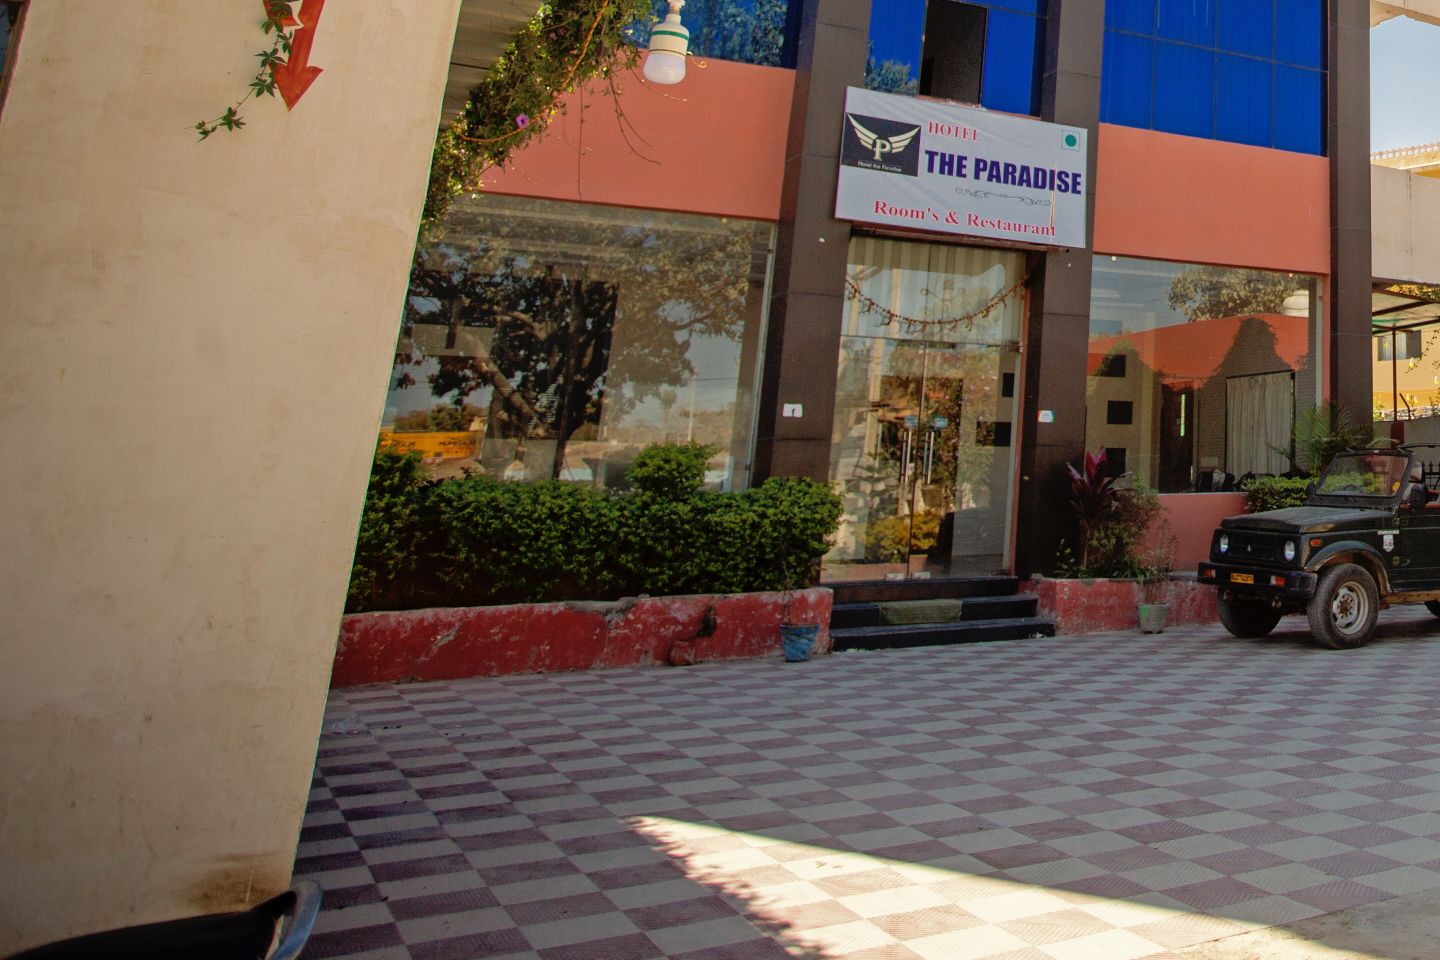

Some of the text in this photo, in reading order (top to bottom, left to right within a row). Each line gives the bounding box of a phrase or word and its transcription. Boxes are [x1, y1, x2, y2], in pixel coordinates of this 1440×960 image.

[928, 121, 979, 142] HOTEL
[925, 150, 1082, 195] THE PARADISE
[873, 200, 1056, 237] Room's & Restaurant
